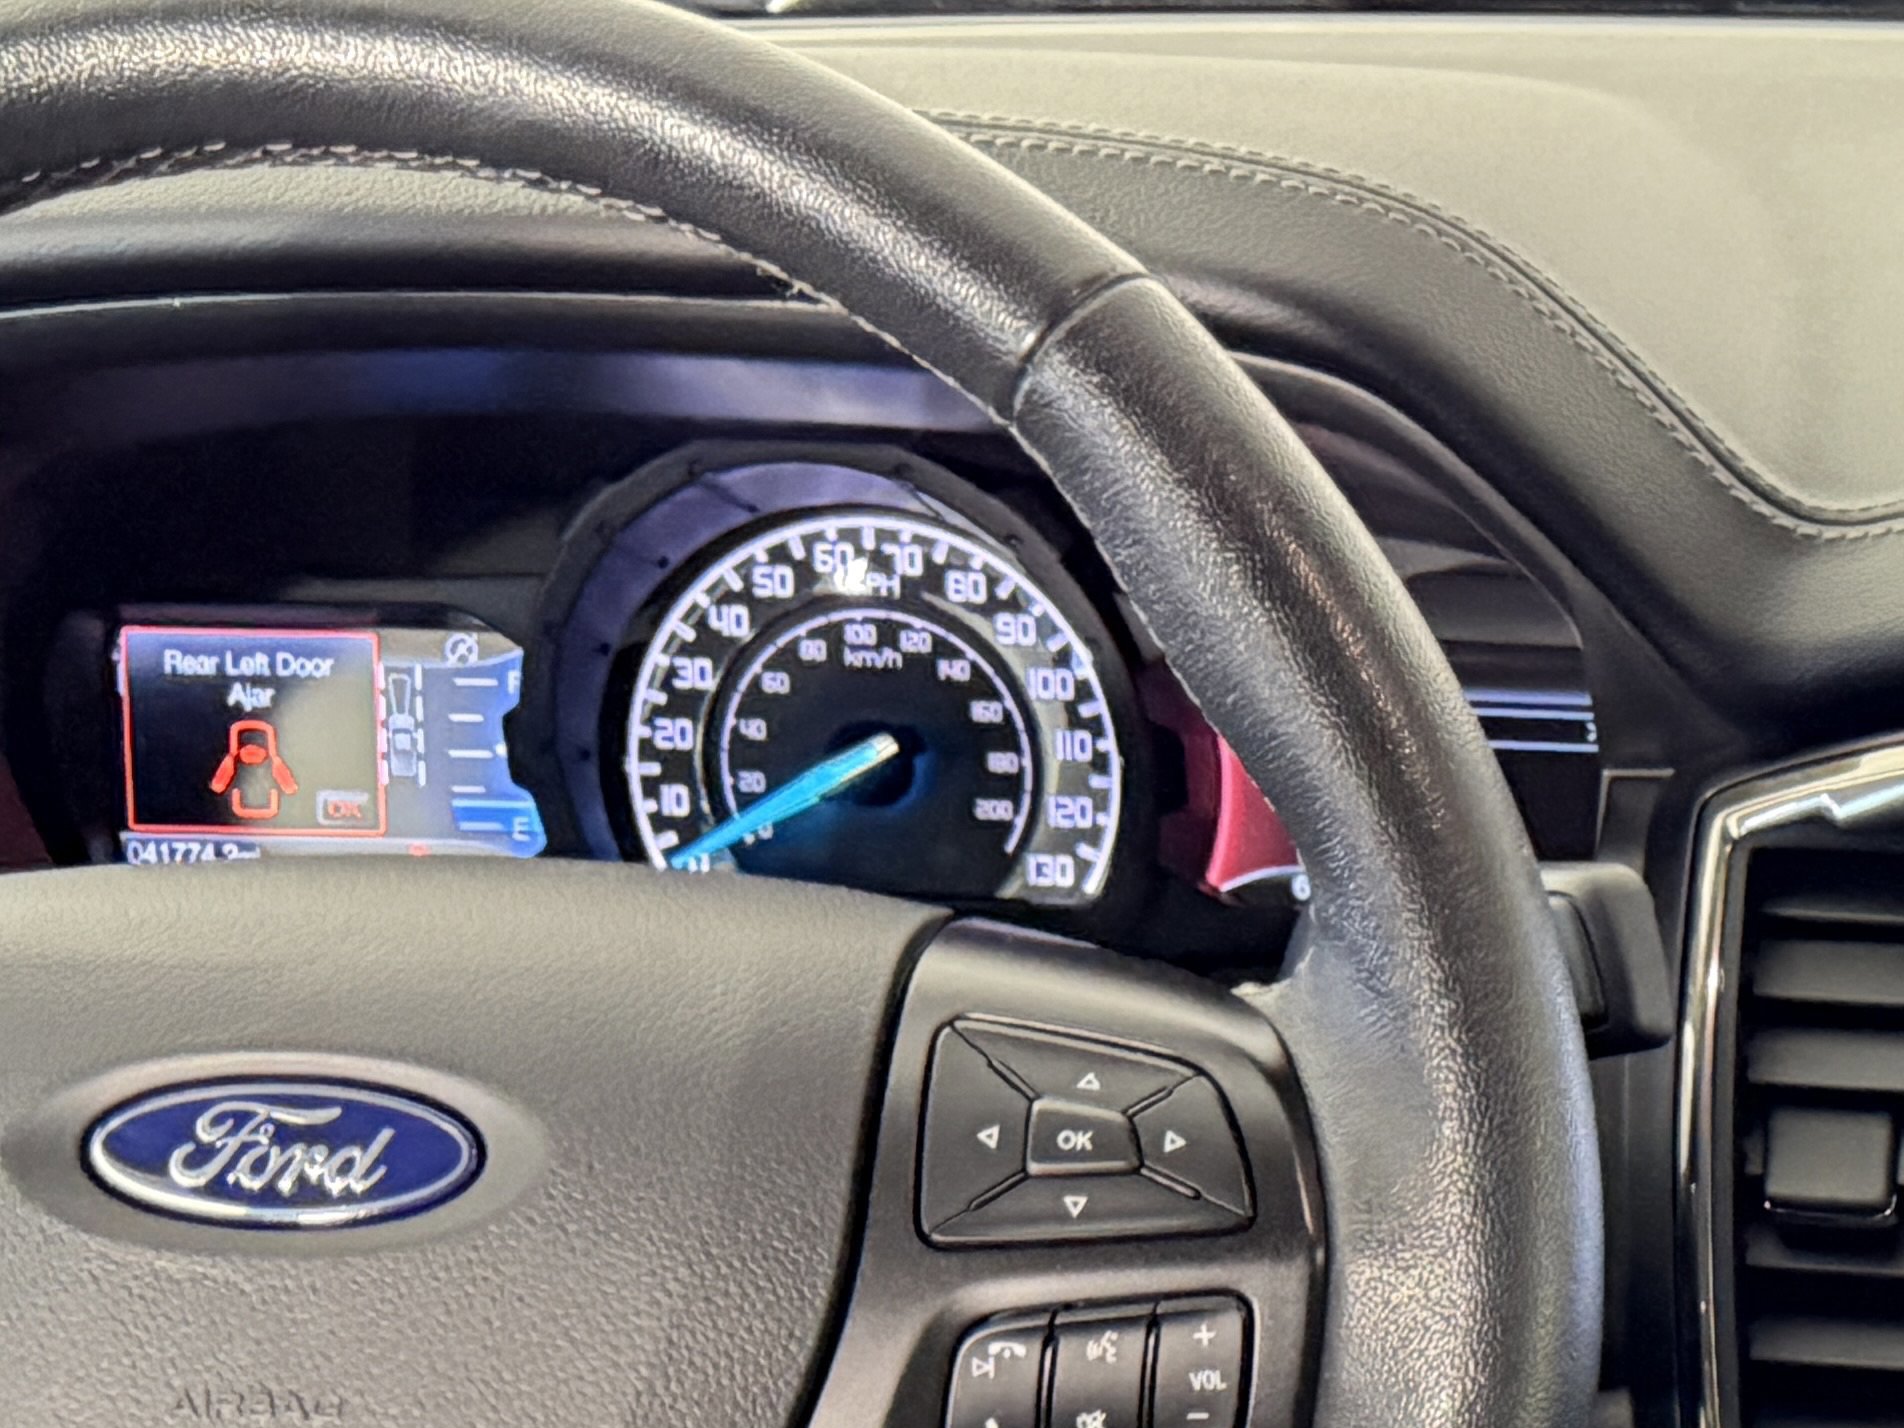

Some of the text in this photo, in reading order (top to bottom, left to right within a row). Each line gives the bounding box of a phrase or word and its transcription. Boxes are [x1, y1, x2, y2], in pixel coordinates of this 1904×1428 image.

[813, 542, 855, 573] 60
[881, 543, 924, 577] 70
[752, 566, 794, 599] 50
[945, 570, 988, 603] 80
[707, 605, 749, 638] 40
[844, 623, 878, 646] 100
[994, 614, 1036, 646] 90
[163, 648, 335, 678] Rear Left Door
[671, 657, 713, 690] 30
[226, 681, 276, 712] Ajar
[1026, 668, 1075, 700] 100
[652, 717, 693, 750] 20
[1055, 729, 1093, 762] 110
[659, 783, 691, 818] 10
[1047, 796, 1093, 829] 120
[512, 816, 531, 841] E
[1026, 854, 1075, 888] 130
[168, 1100, 396, 1199] Ford
[1056, 1129, 1094, 1151] OK
[1188, 1369, 1228, 1391] VOL
